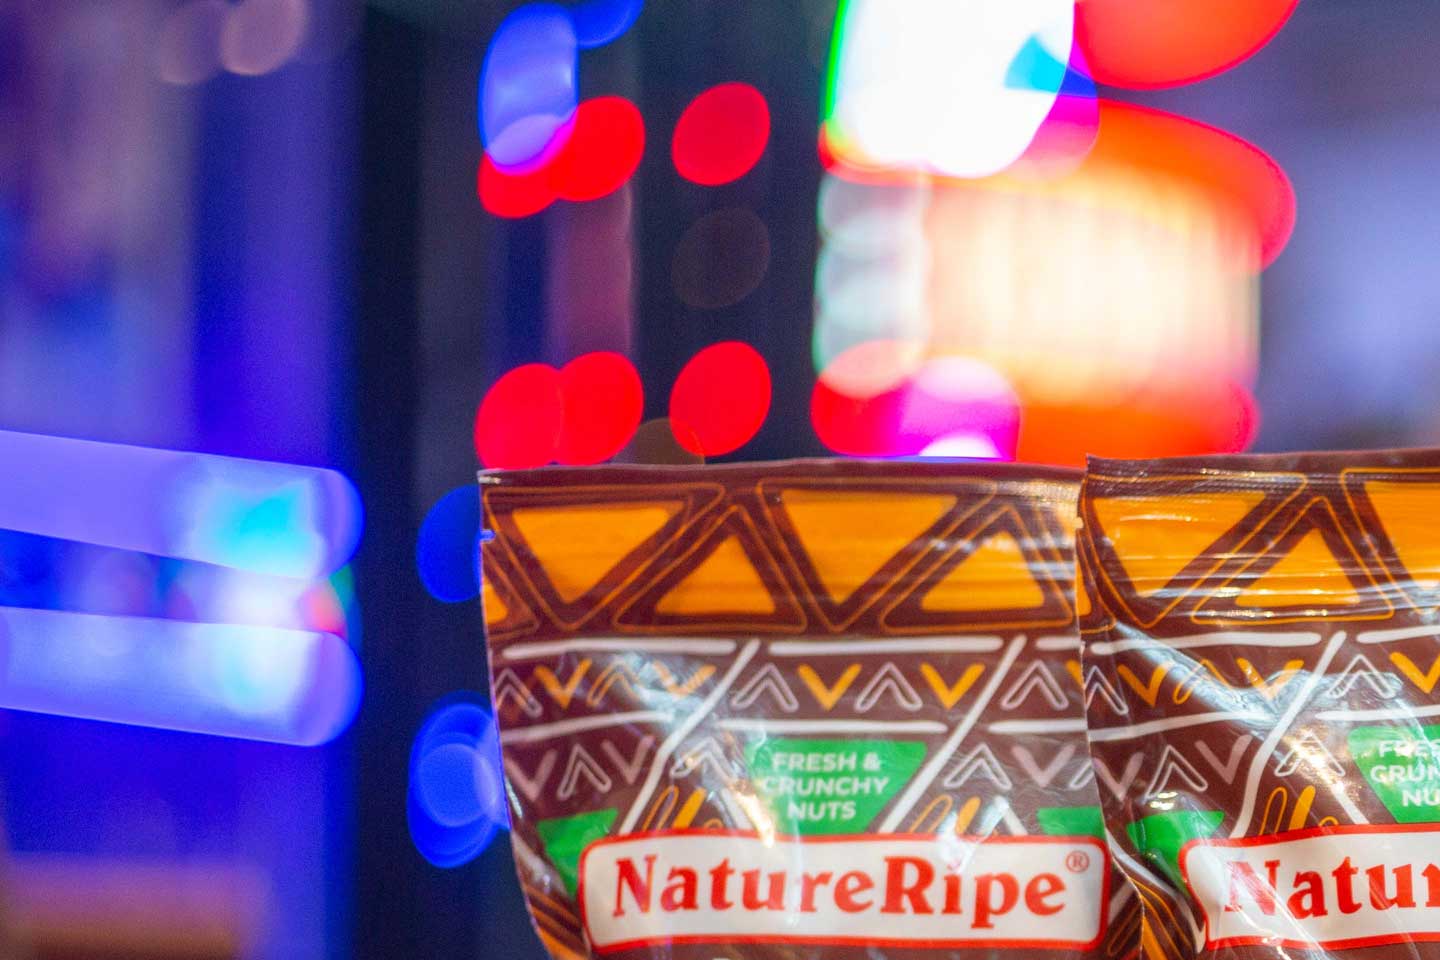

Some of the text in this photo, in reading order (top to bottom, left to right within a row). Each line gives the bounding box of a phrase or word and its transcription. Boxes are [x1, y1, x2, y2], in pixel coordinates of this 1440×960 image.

[772, 751, 881, 772] FRESH &
[761, 776, 889, 796] CRUNCHY
[787, 800, 857, 820] NUTS
